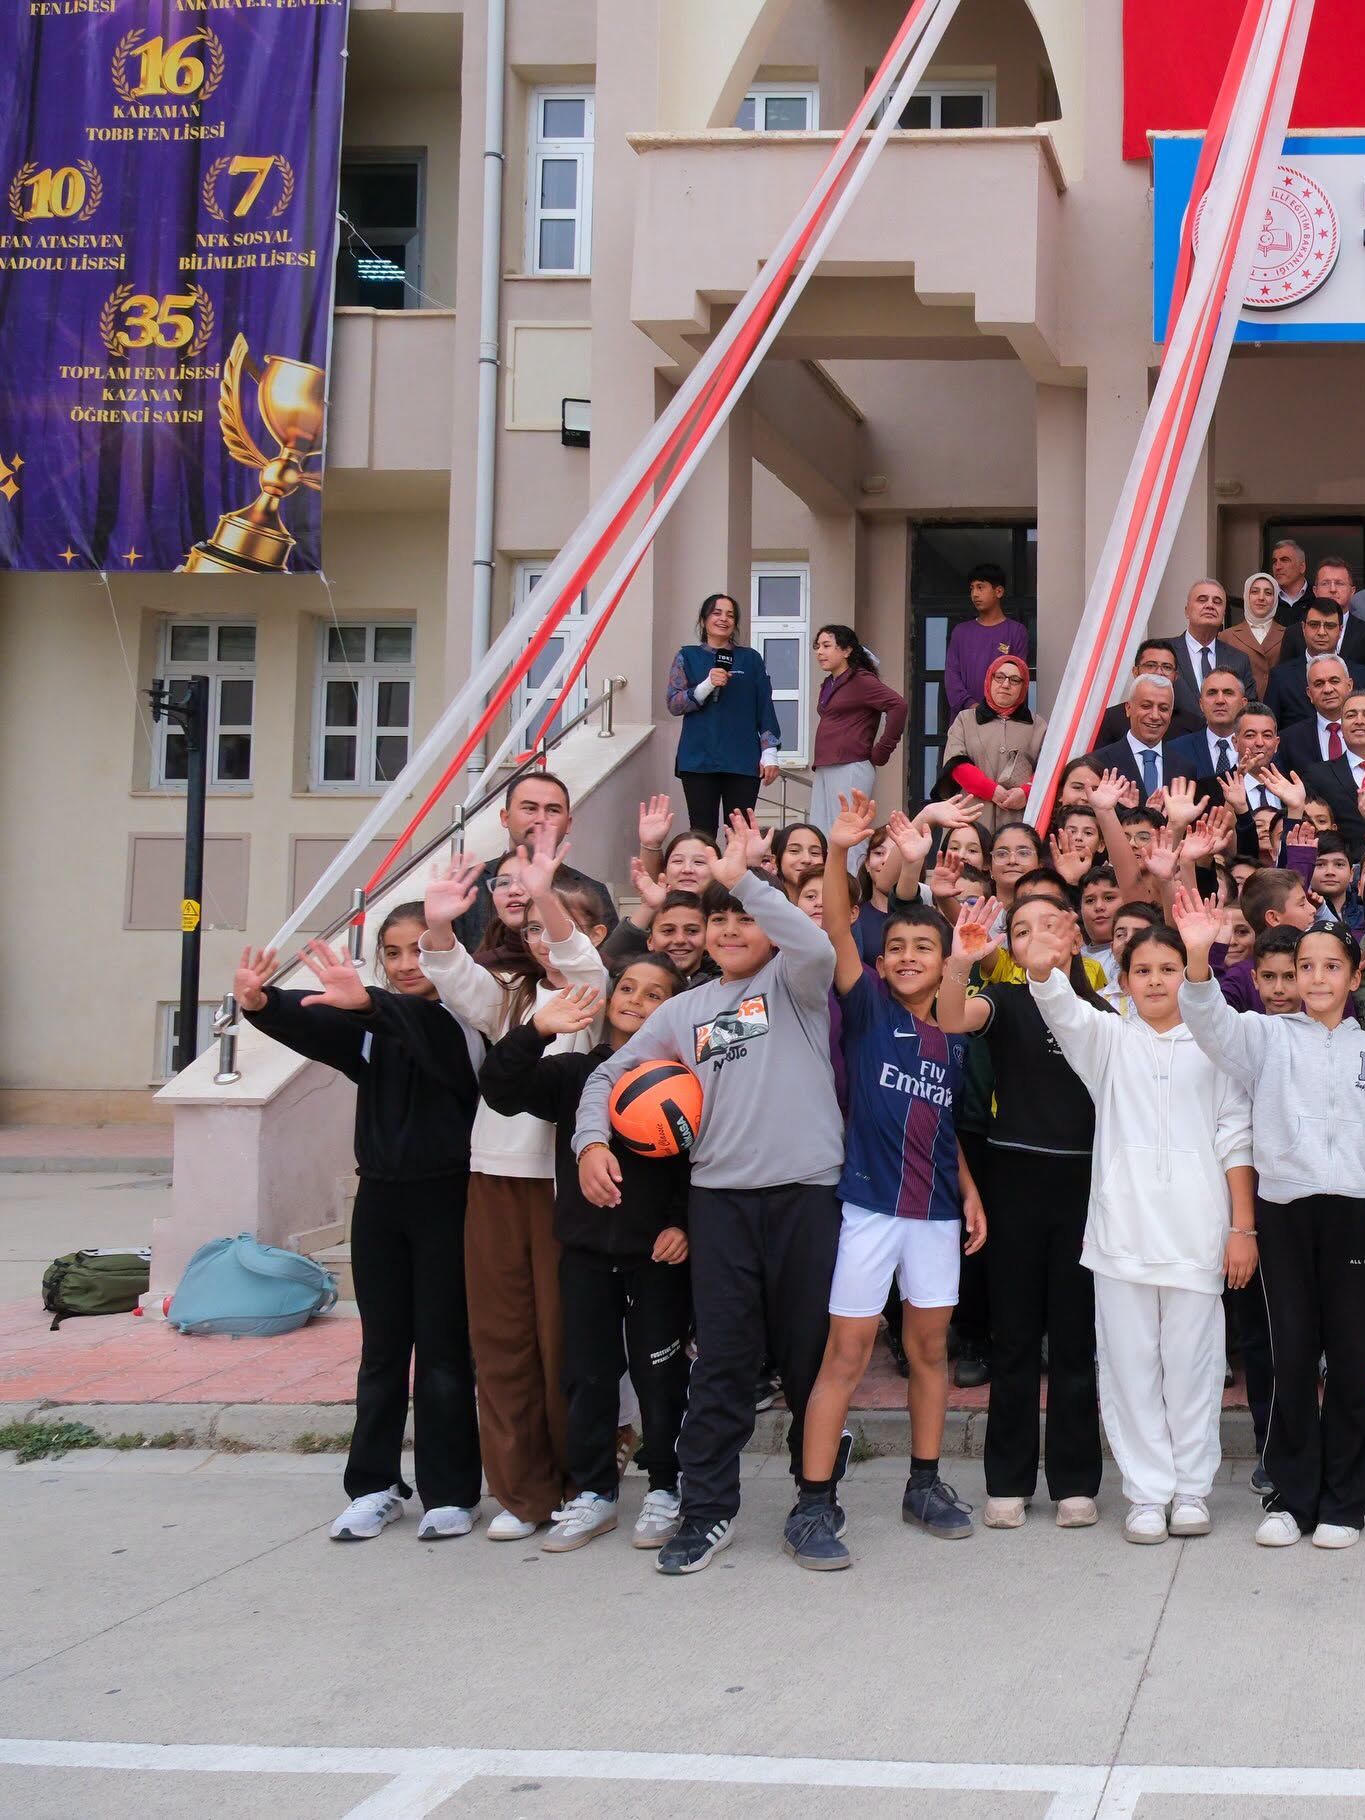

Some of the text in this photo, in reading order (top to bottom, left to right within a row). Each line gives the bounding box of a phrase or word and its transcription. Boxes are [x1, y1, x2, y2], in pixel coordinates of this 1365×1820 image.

[30, 2, 61, 15] FEN
[129, 35, 206, 97] 16
[112, 105, 201, 118] KARAMAN
[86, 121, 225, 141] TOBB FEN LİSESİ
[23, 167, 86, 219] 10
[228, 155, 276, 217] 7
[0, 234, 124, 248] FAN ATASEVEN
[196, 229, 292, 248] NFK SOSYAL
[0, 253, 126, 270] NADOLU LİSESİ
[178, 250, 317, 270] BİLİMLER LİSESİ
[115, 294, 197, 348] 35
[60, 362, 220, 380] TOPLAM FEN LİSESİ
[102, 388, 184, 402] KAZANAN
[70, 406, 203, 423] ÖĞRENCİ SAYISI
[920, 1060, 946, 1084] Fly
[879, 1061, 953, 1108] Emirat
